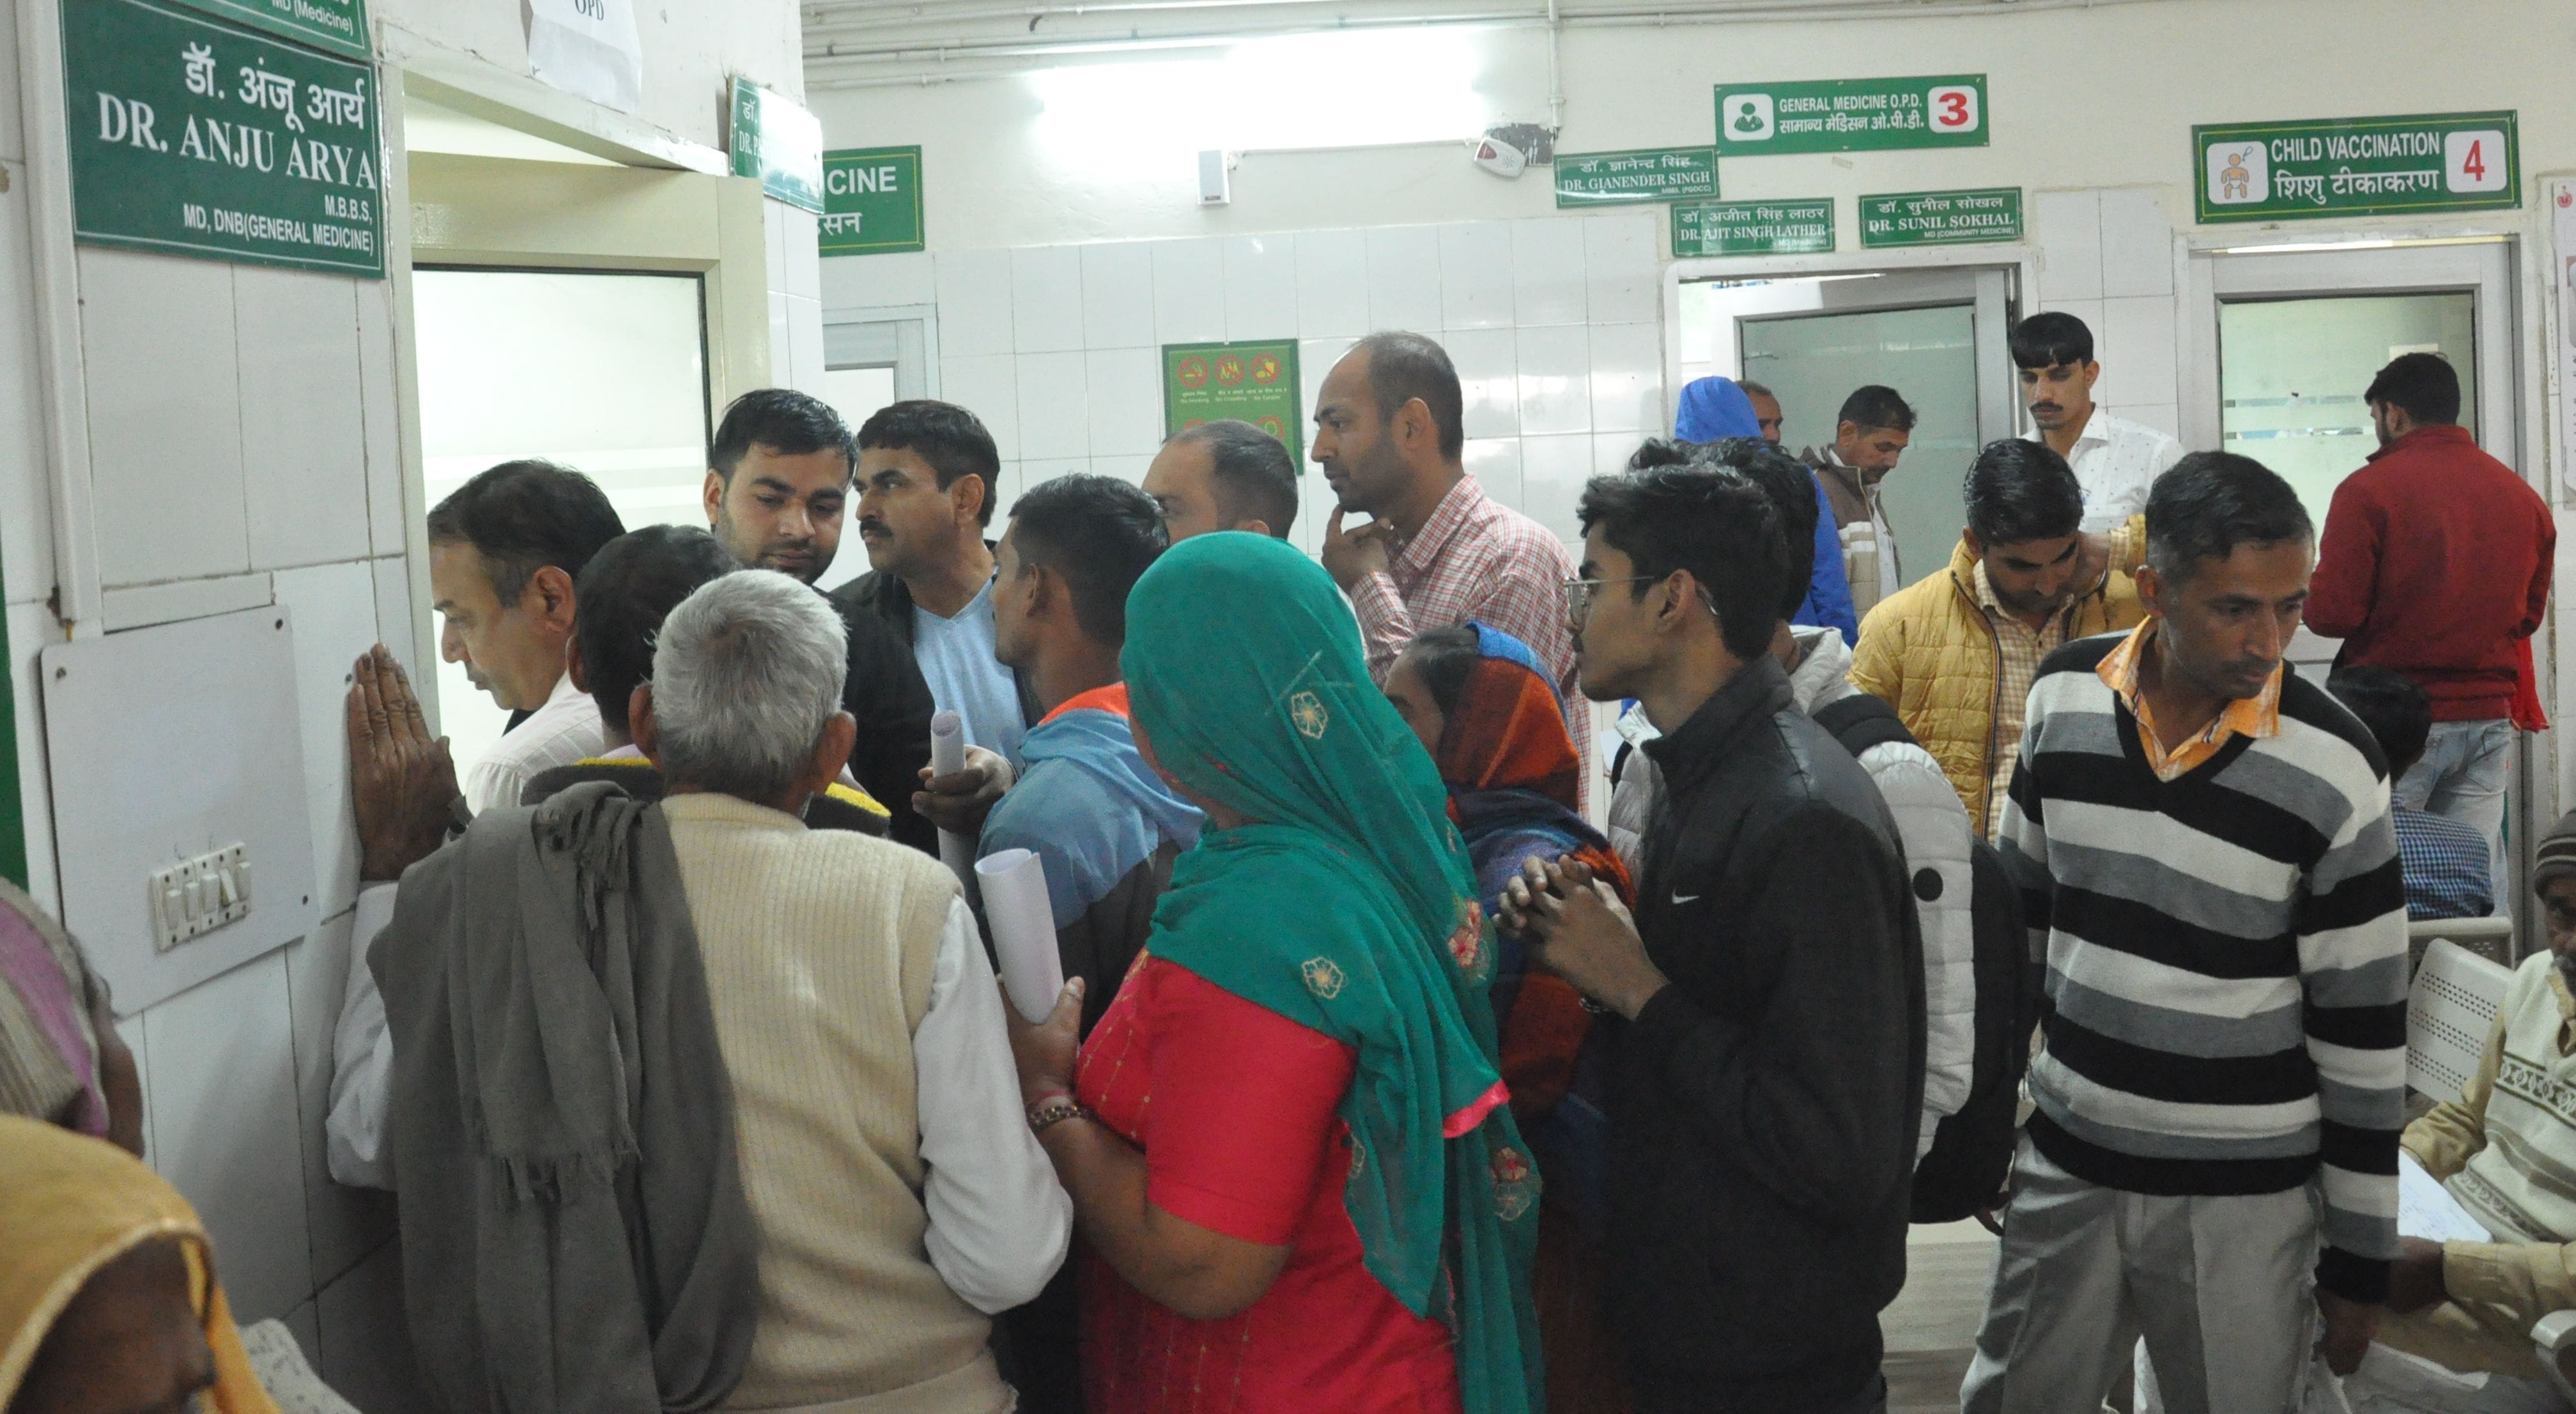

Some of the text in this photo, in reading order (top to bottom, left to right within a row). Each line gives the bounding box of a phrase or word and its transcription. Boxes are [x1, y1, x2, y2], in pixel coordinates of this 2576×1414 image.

[293, 0, 353, 36] (Medicine)
[181, 42, 366, 134] डॉ. अंजू आर्य
[741, 98, 758, 124] डॉ.
[1779, 93, 1922, 112] GENERAL MEDICINE O.P.D.
[1938, 92, 1969, 127] 3
[1779, 118, 1823, 134] सामान्य
[1824, 112, 1869, 132] मेडिसन
[96, 91, 378, 190] DR. ANJU ARYA
[738, 130, 752, 155] DR.
[2271, 131, 2441, 162] CHILD VACCINATION
[1579, 159, 1603, 174] डॉ.
[1661, 155, 1691, 169] सिंह
[2463, 139, 2485, 182] 4
[1565, 171, 1711, 191] DR. GIANENDER SINGH
[2274, 165, 2441, 205] शिशु टीकाकरण
[324, 194, 373, 226] M.B.B.S,
[1709, 207, 1752, 222] अजीत
[1756, 206, 1784, 220] सिंह
[1787, 208, 1825, 220] लाठर
[1878, 196, 2003, 216] डॉ. सुनील सोखल
[183, 202, 212, 234] MD,
[312, 223, 374, 257] MEDICINE)
[1680, 224, 1826, 241] DR. AJIT SINGH LATHER
[1869, 213, 2014, 234] DR. SUNIL SOKHAL
[1937, 229, 1979, 238] (COMMUNITY
[1980, 227, 2015, 236] MEDICINE)
